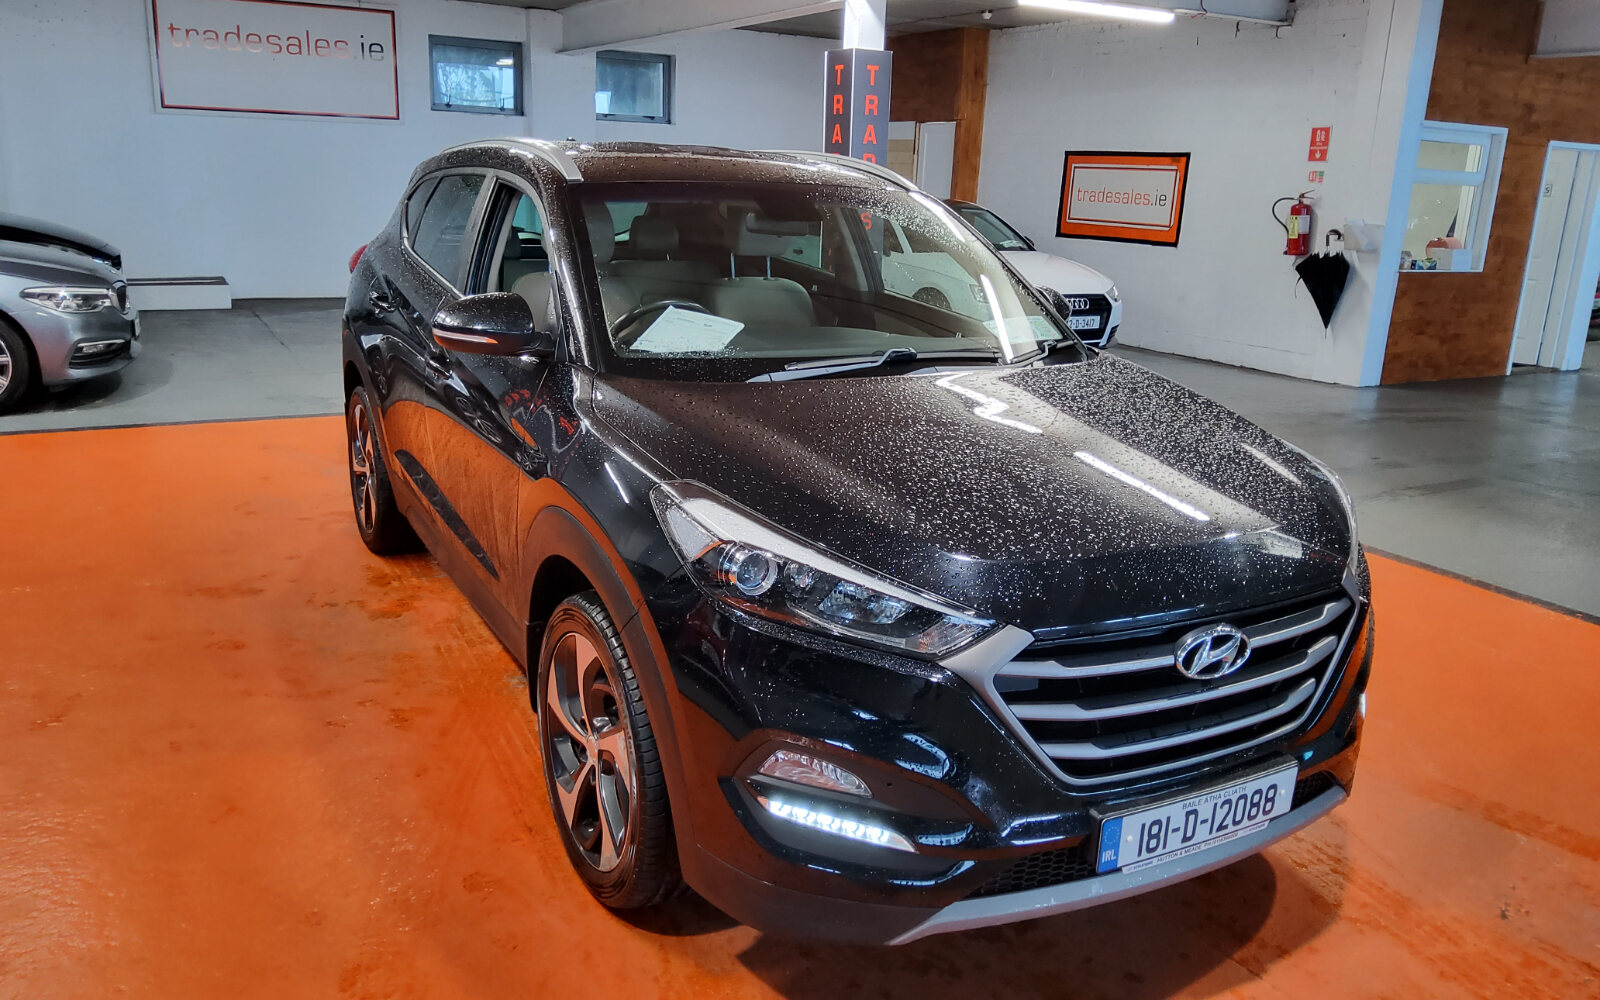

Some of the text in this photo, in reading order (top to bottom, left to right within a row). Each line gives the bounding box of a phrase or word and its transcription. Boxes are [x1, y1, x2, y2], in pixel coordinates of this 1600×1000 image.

[168, 22, 385, 62] tradesales.ie
[832, 64, 845, 155] TRA
[1077, 187, 1167, 207] tradesales.ie
[1066, 319, 1095, 329] 2-D-3417
[1182, 799, 1201, 810] BAILE
[1223, 786, 1247, 798] CLIATH
[1137, 784, 1278, 857] 181-D-12088
[1102, 849, 1117, 863] IRL
